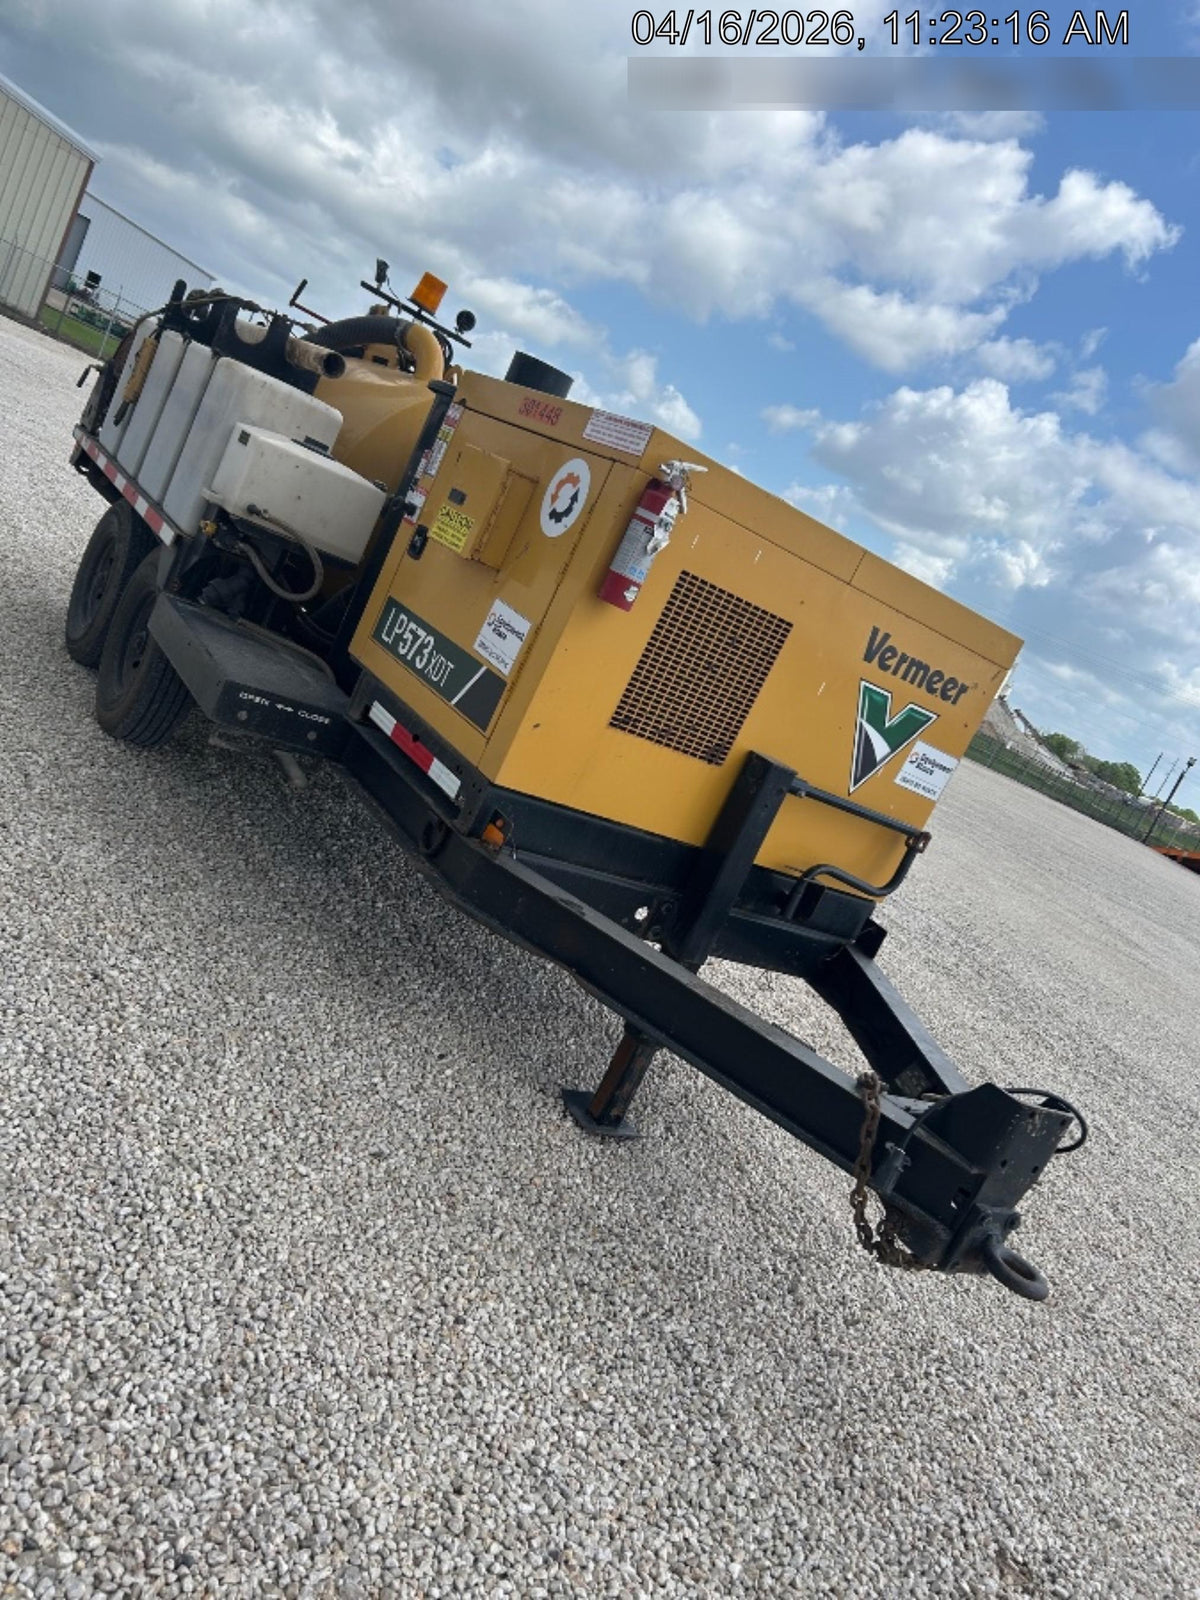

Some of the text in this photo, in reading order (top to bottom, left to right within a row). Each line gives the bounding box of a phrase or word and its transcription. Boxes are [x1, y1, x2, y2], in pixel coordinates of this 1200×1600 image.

[863, 625, 970, 705] Vermeer
[239, 691, 330, 725] OPEN CLOSE
